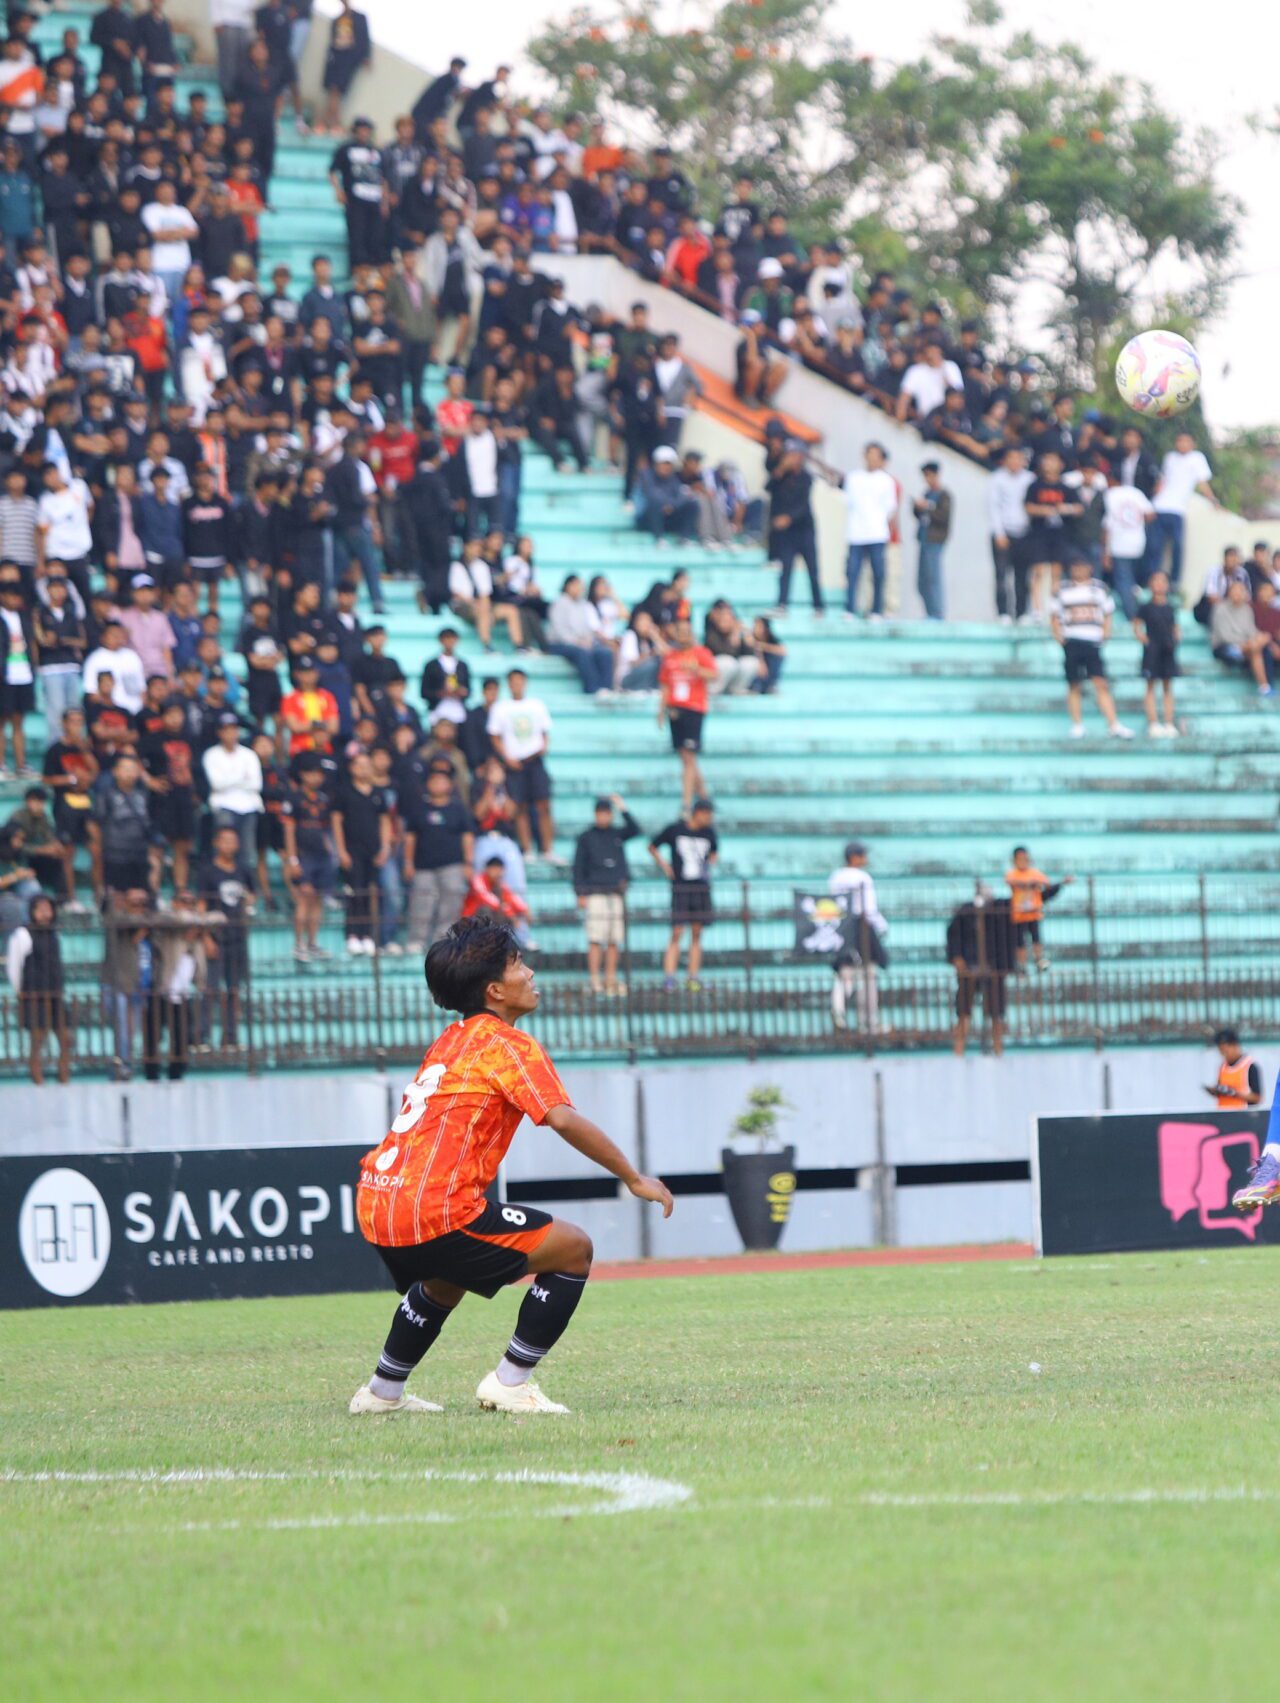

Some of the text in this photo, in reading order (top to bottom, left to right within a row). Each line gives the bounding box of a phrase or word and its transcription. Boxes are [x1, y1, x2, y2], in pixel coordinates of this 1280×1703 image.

[362, 1171, 404, 1188] SAKOPI
[124, 1185, 354, 1243] SAKOPI
[502, 1207, 527, 1226] 8
[206, 1247, 245, 1264] AND
[251, 1244, 313, 1262] RESTO
